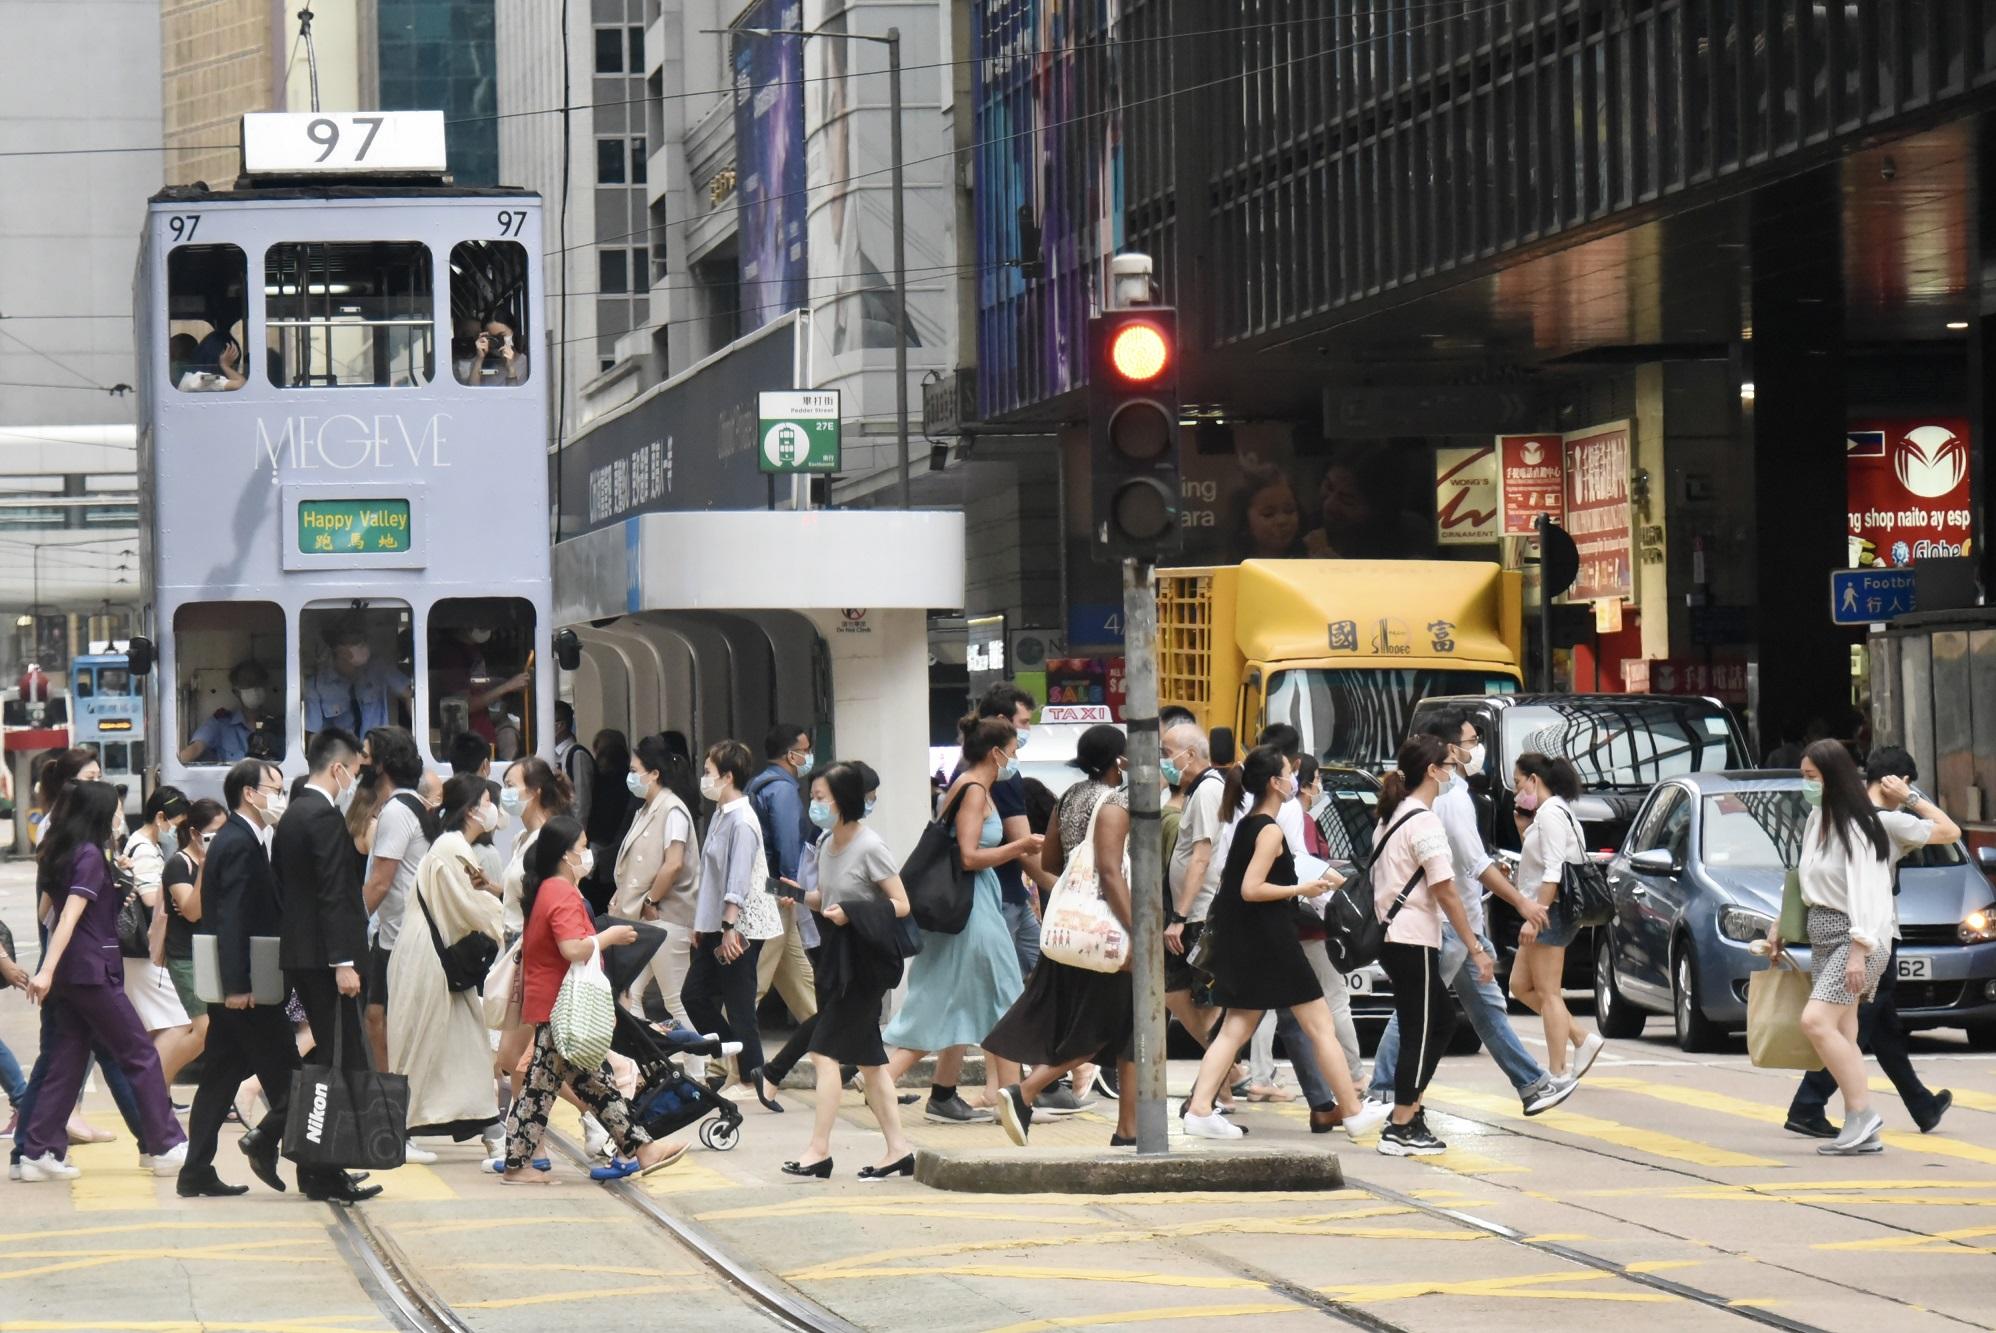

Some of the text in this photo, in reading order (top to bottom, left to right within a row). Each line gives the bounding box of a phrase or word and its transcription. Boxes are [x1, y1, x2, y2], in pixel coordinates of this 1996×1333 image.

[307, 117, 384, 163] 97
[169, 215, 200, 241] 97
[497, 211, 527, 237] 97
[816, 422, 834, 431] 27E
[254, 413, 453, 470] MEGEVE
[1450, 478, 1489, 486] WONG'S
[303, 510, 407, 531] Happy Valley
[1864, 507, 1895, 532] shop
[1897, 506, 1928, 527] naito
[1930, 510, 1945, 531] ay
[314, 532, 398, 551] 跑馬地
[1427, 620, 1456, 653] 富
[1049, 686, 1104, 703] SALE
[1049, 708, 1105, 720] TAXI
[1898, 960, 1925, 977] 62
[306, 1082, 328, 1144] Nikon
